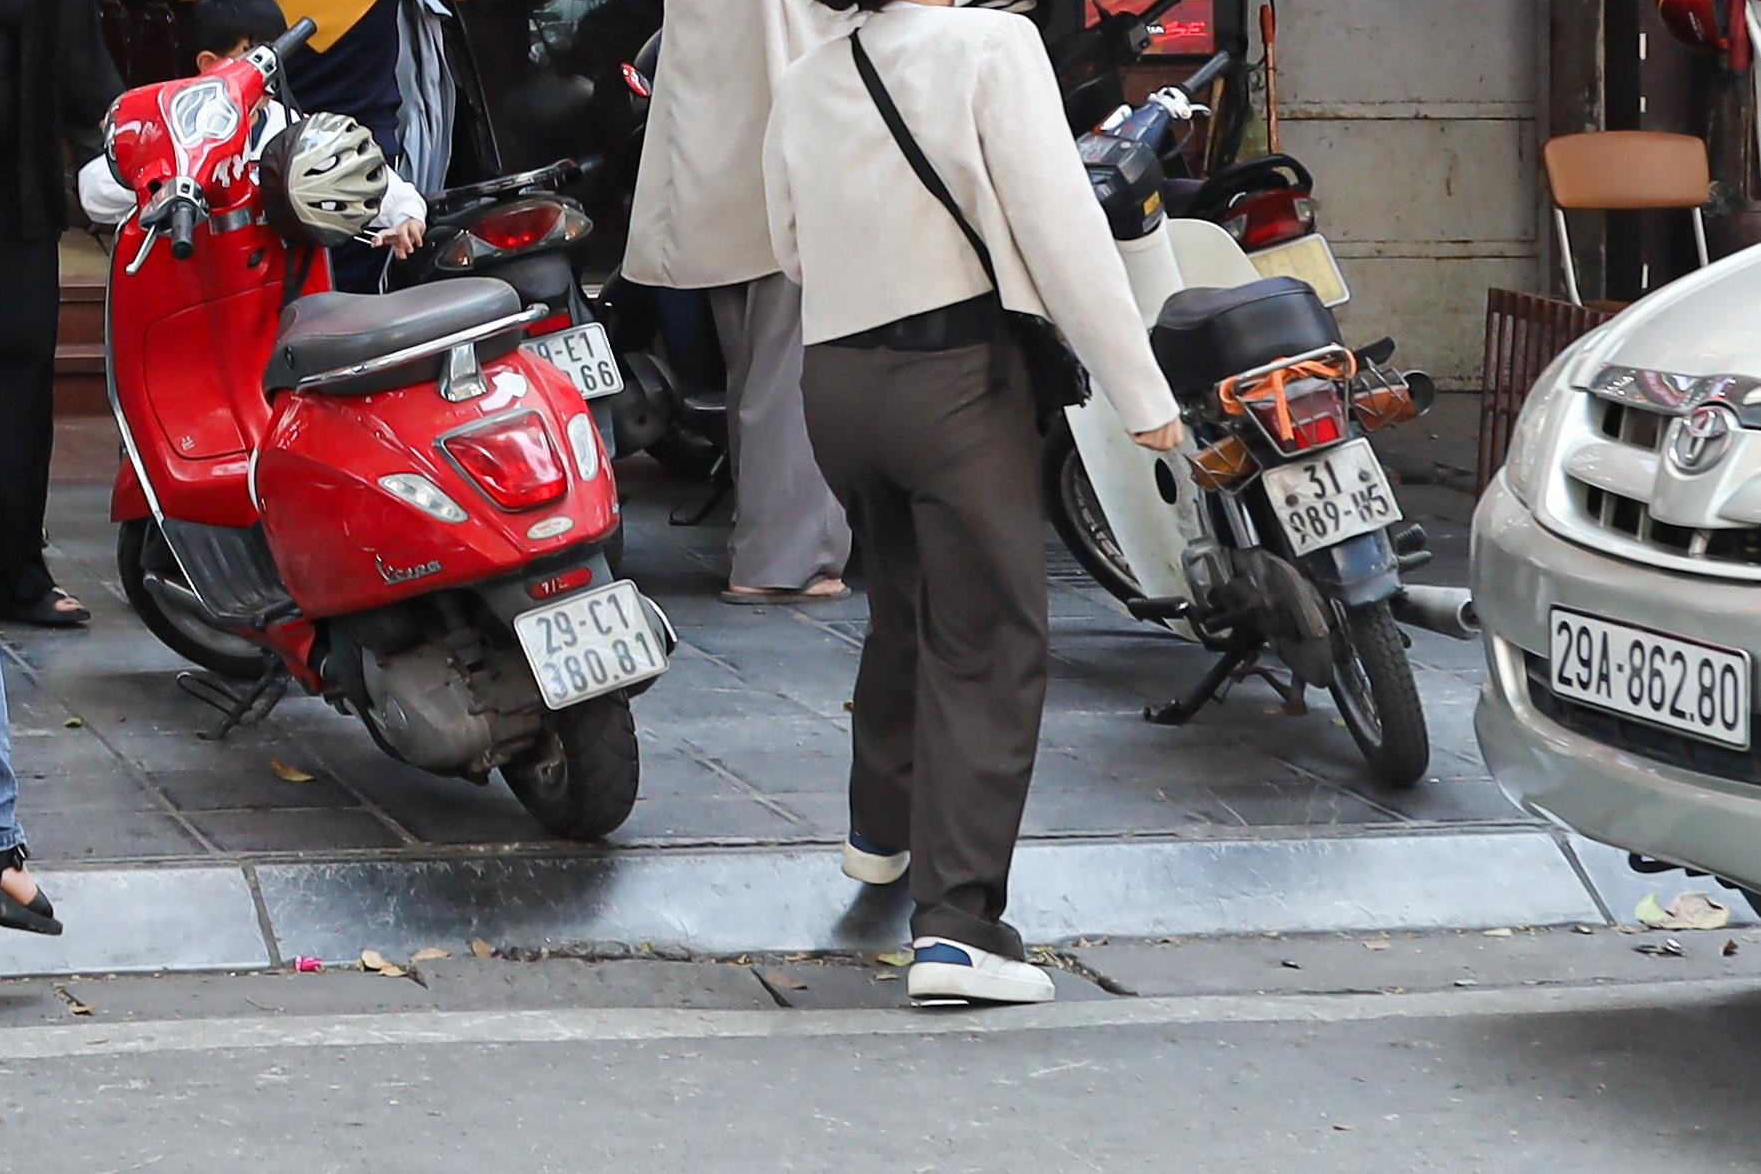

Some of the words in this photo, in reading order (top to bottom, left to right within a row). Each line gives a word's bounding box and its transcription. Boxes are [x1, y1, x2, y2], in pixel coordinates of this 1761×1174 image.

[525, 331, 595, 367] 9-E1
[1303, 460, 1342, 500] 31
[374, 553, 443, 586] Vespa
[536, 592, 631, 655] 29-C1
[538, 630, 657, 700] 380.81
[1556, 619, 1740, 731] 29A-862.80
